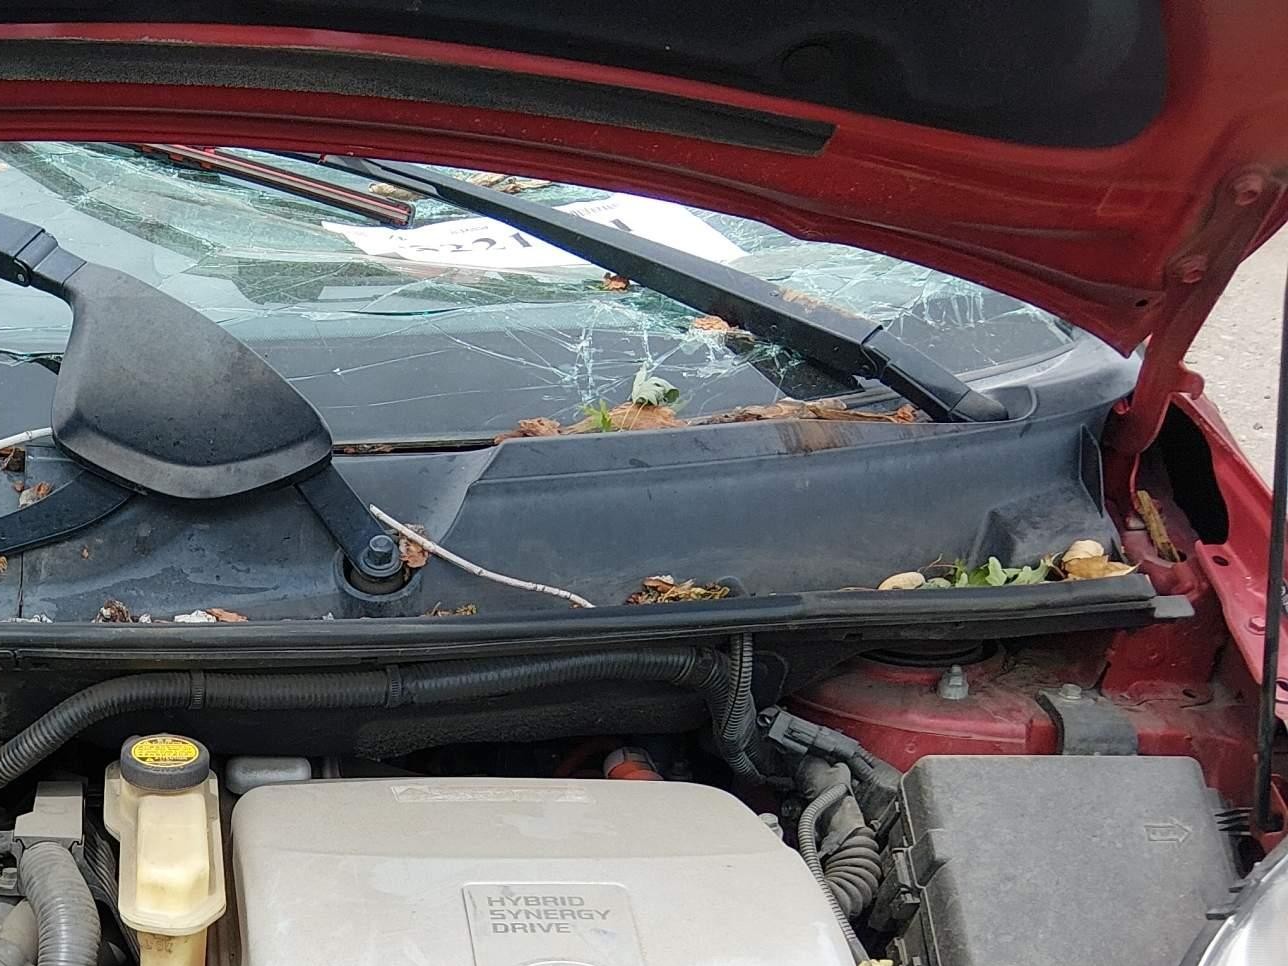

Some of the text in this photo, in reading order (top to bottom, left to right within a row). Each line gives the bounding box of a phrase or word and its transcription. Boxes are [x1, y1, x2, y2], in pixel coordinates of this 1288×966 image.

[487, 896, 585, 907] HYBRID
[489, 909, 611, 920] SYNERGY
[491, 922, 572, 934] DRIVE
